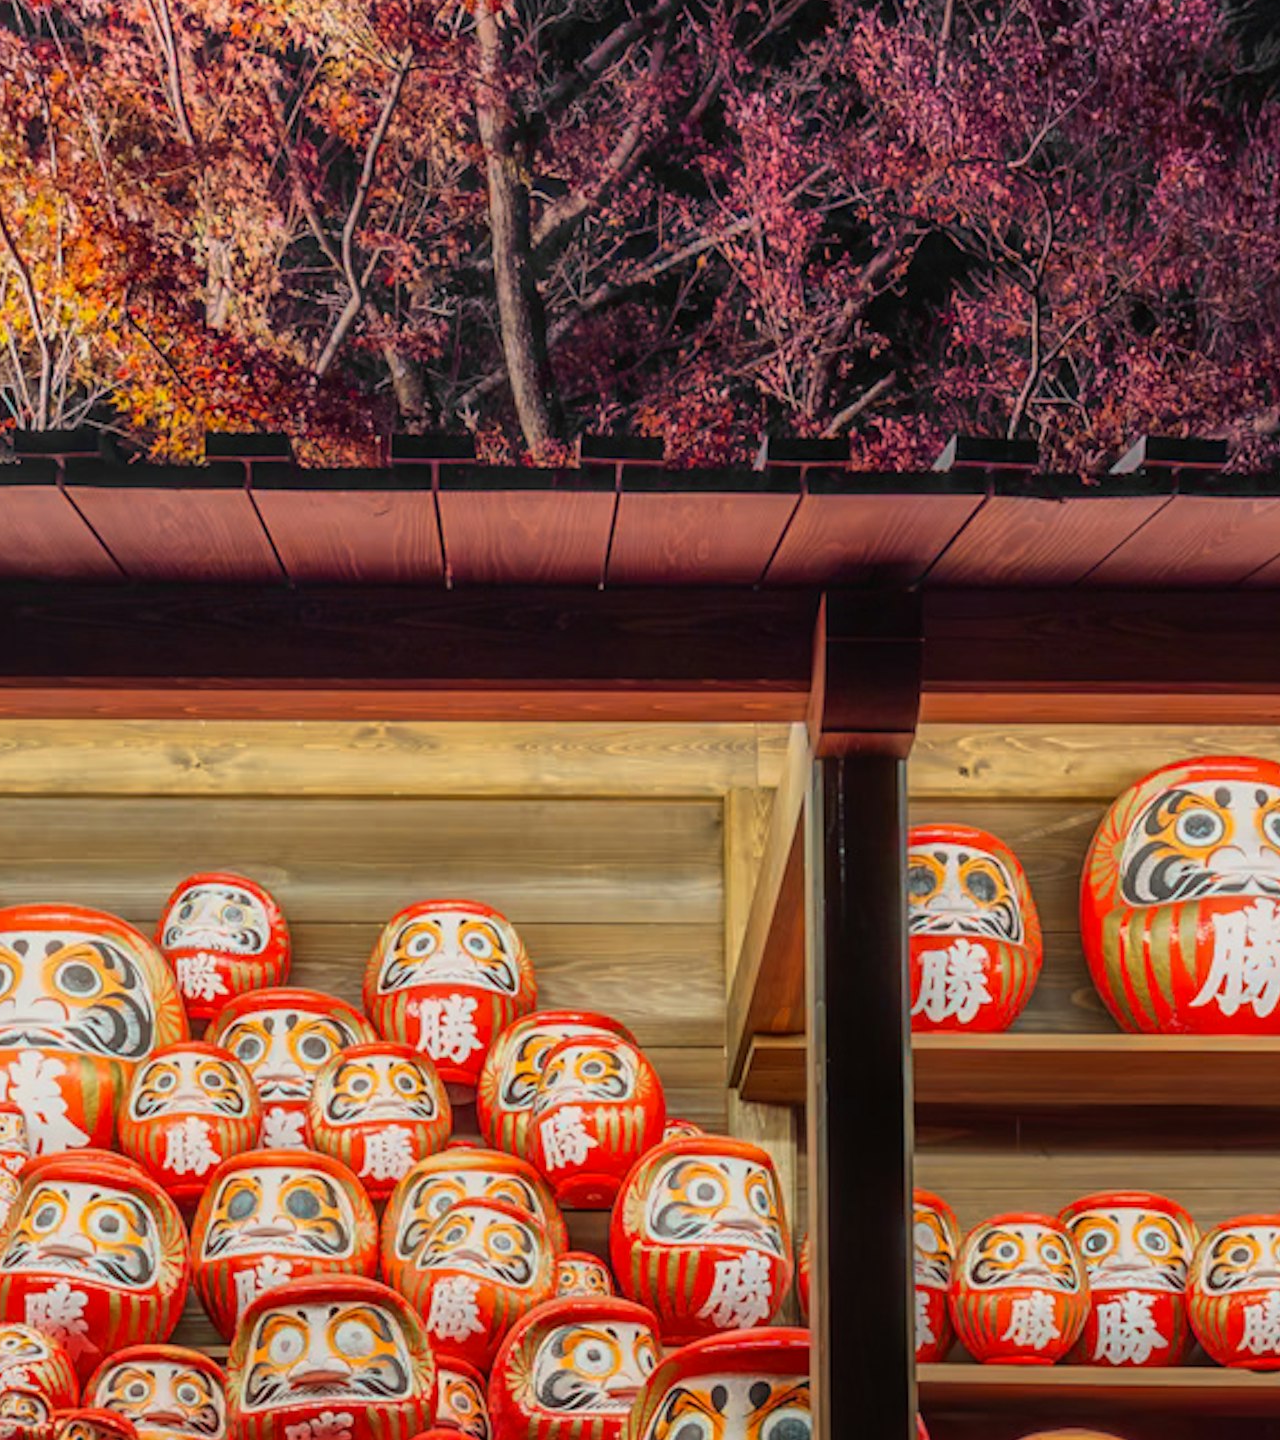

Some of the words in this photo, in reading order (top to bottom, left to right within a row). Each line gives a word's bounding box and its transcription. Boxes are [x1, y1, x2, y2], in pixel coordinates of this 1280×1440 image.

[175, 953, 227, 1000] 勝
[911, 938, 993, 1023] 勝
[417, 994, 486, 1065] 勝
[163, 1117, 222, 1176] 勝
[363, 1125, 415, 1181] 勝
[541, 1107, 599, 1171] 勝
[26, 1282, 99, 1359] 勝
[425, 1278, 483, 1342] 勝
[699, 1251, 772, 1329] 勝
[1006, 1290, 1057, 1351] 勝
[1093, 1290, 1169, 1364] 勝
